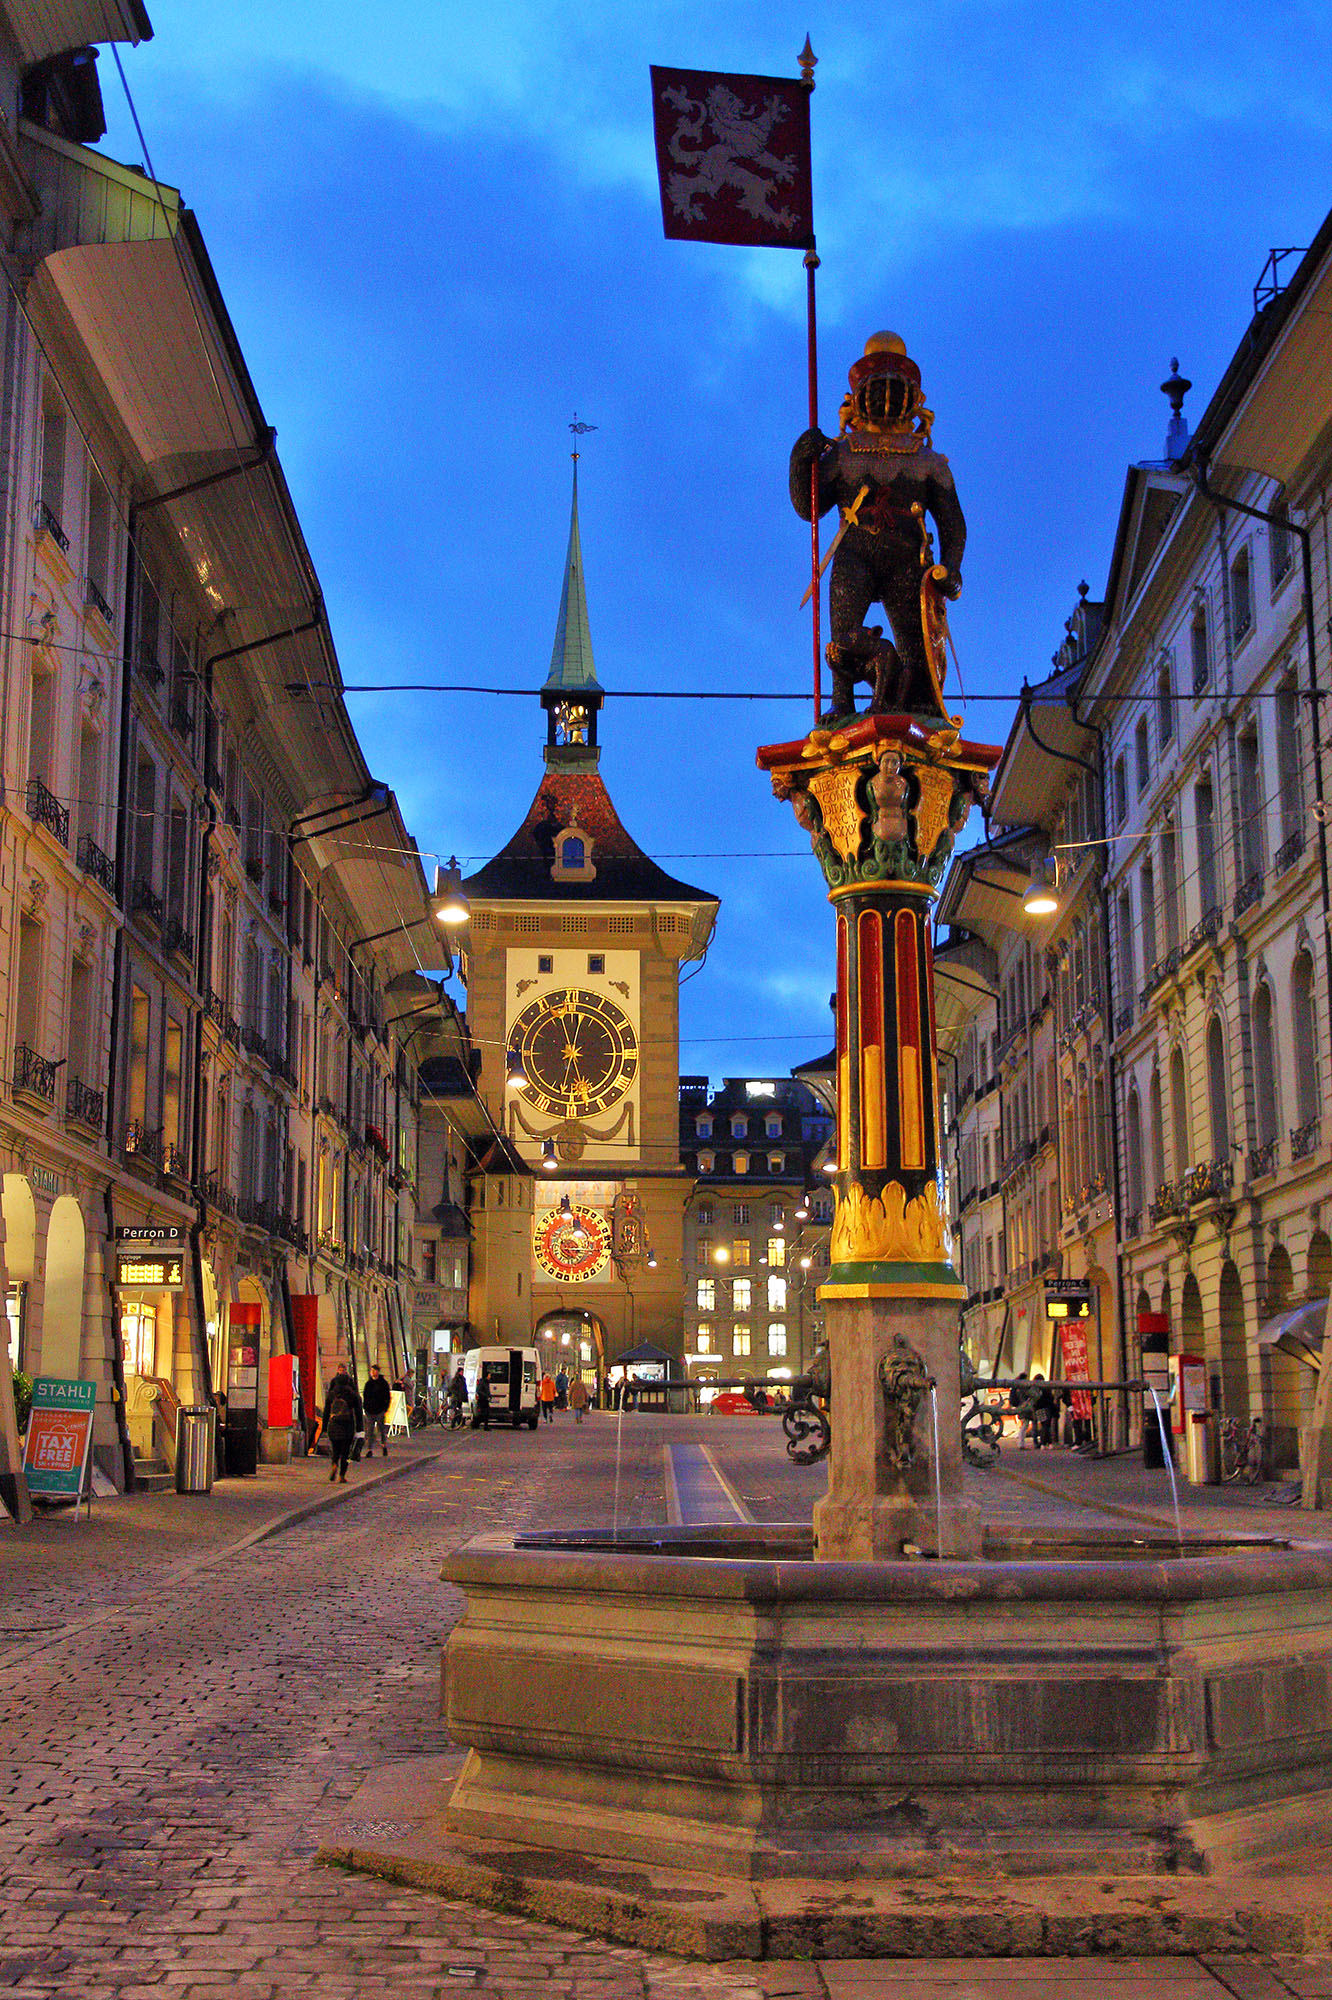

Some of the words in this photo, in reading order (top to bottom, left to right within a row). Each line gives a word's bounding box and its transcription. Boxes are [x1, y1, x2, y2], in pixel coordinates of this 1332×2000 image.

[123, 1227, 165, 1238] Perron
[170, 1227, 178, 1237] D
[38, 1383, 92, 1399] STÄHLI
[41, 1435, 74, 1450] TAX
[38, 1448, 72, 1462] FREE
